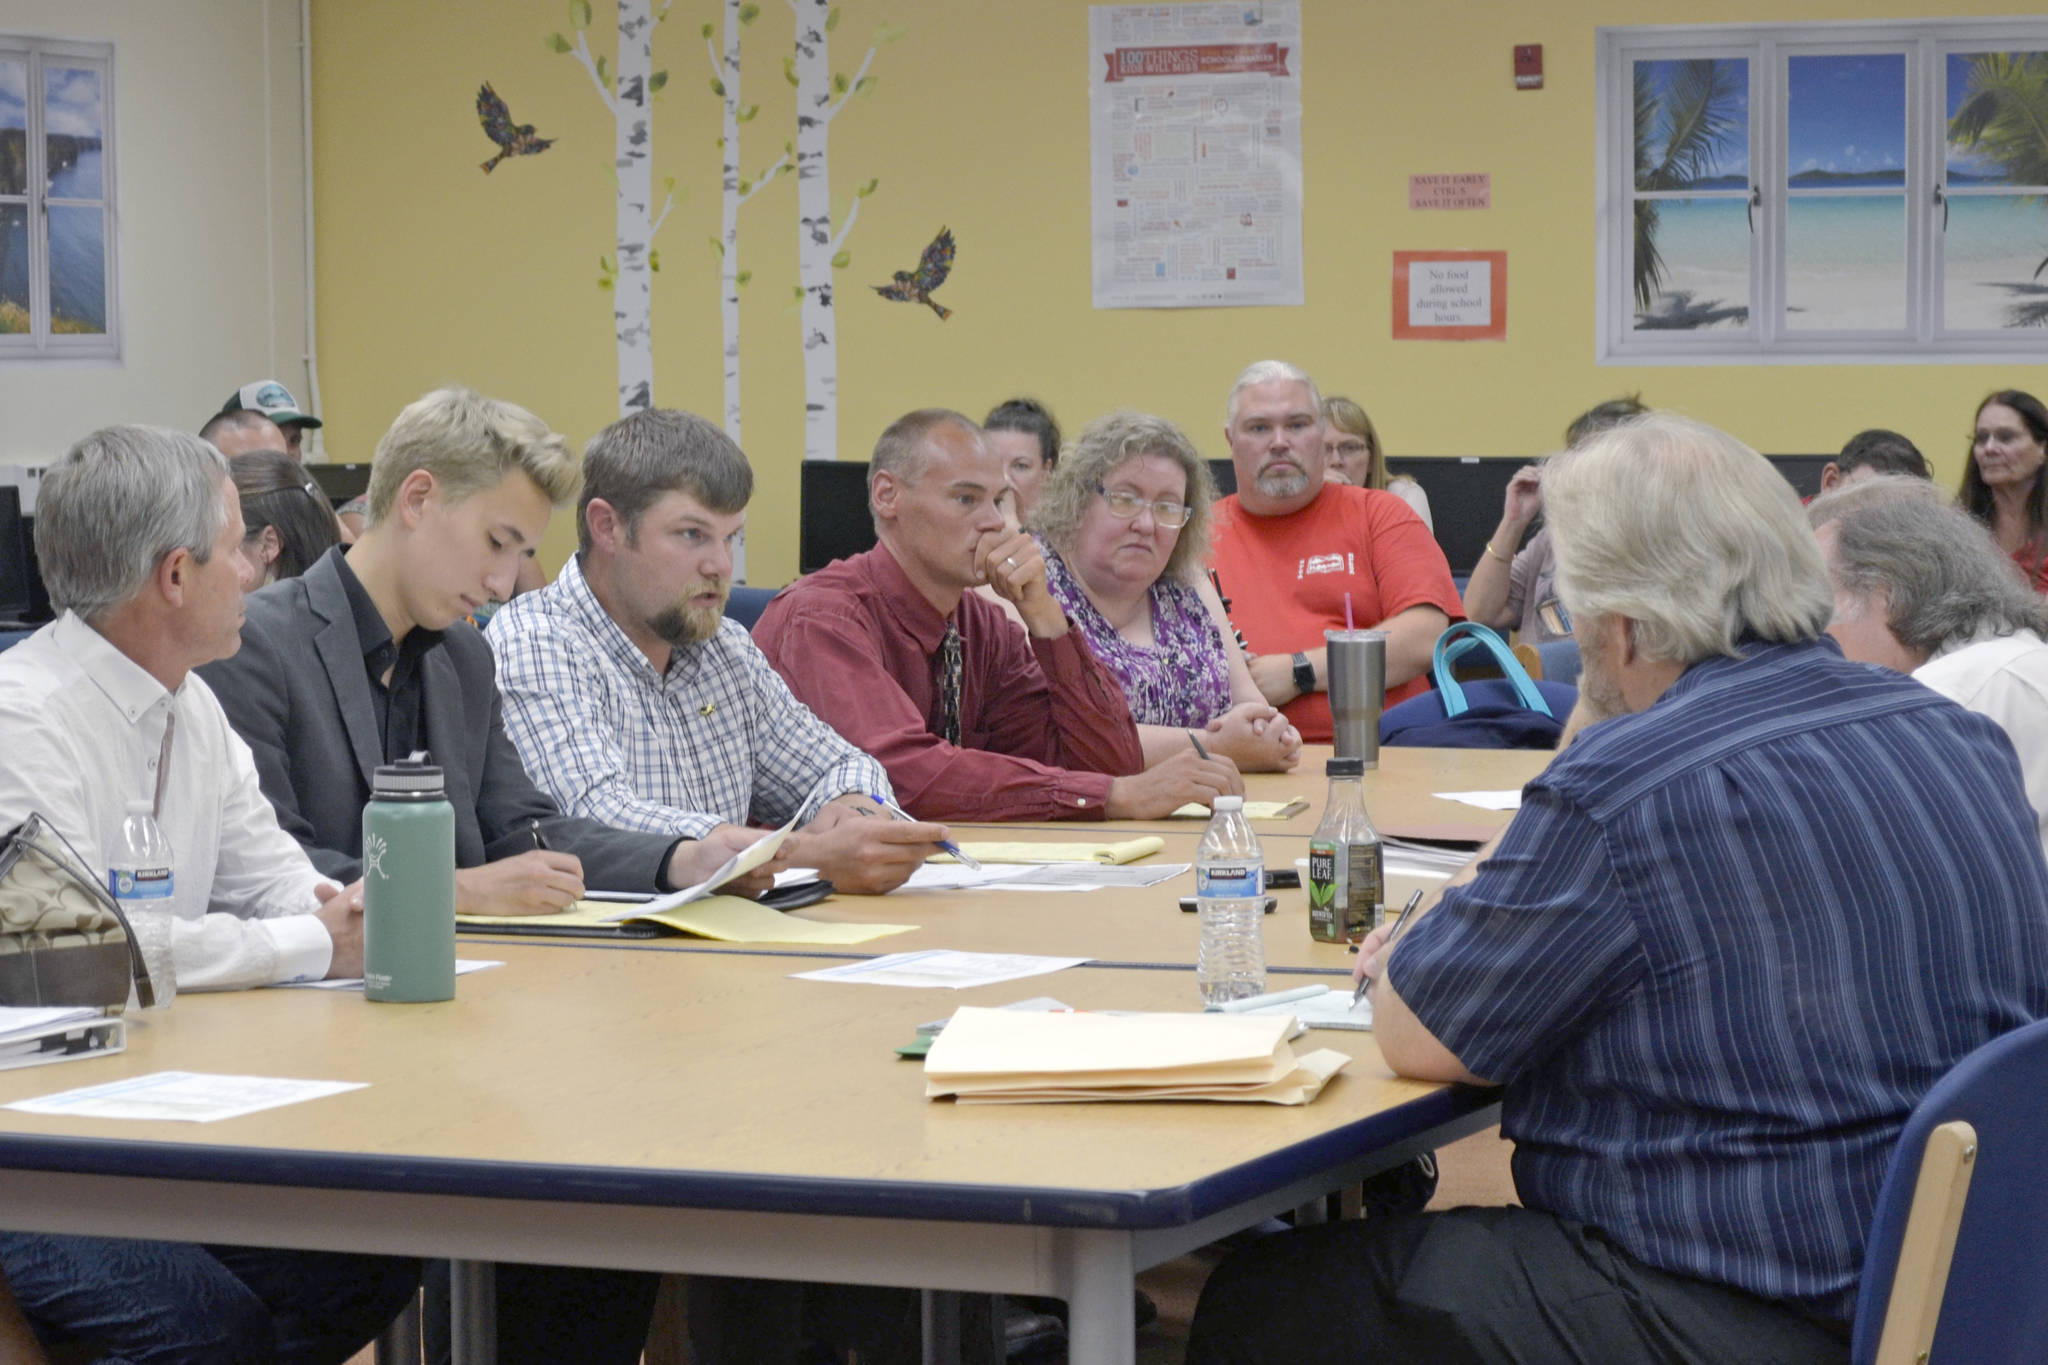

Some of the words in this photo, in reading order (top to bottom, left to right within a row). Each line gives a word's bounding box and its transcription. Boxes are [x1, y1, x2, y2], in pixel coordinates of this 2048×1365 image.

[1120, 50, 1144, 65] 100
[1144, 48, 1198, 64] THINGS
[1120, 63, 1144, 74] KIDS
[1145, 63, 1169, 74] WILL
[1172, 62, 1198, 73] MISS
[1415, 176, 1439, 185] SAVE
[1453, 175, 1485, 185] EARLY
[1415, 199, 1439, 208] SAVE
[1441, 199, 1451, 208] IT
[1453, 199, 1486, 208] OFTEN
[1430, 270, 1445, 280] No
[1447, 269, 1469, 280] food
[1430, 284, 1468, 295] allowed
[1416, 298, 1448, 311] during
[1451, 297, 1482, 308] school
[1312, 857, 1331, 869] PURE
[137, 869, 168, 878] KIRKLAND
[1211, 869, 1246, 877] KIRKLAND
[1312, 868, 1331, 880] LEAF
